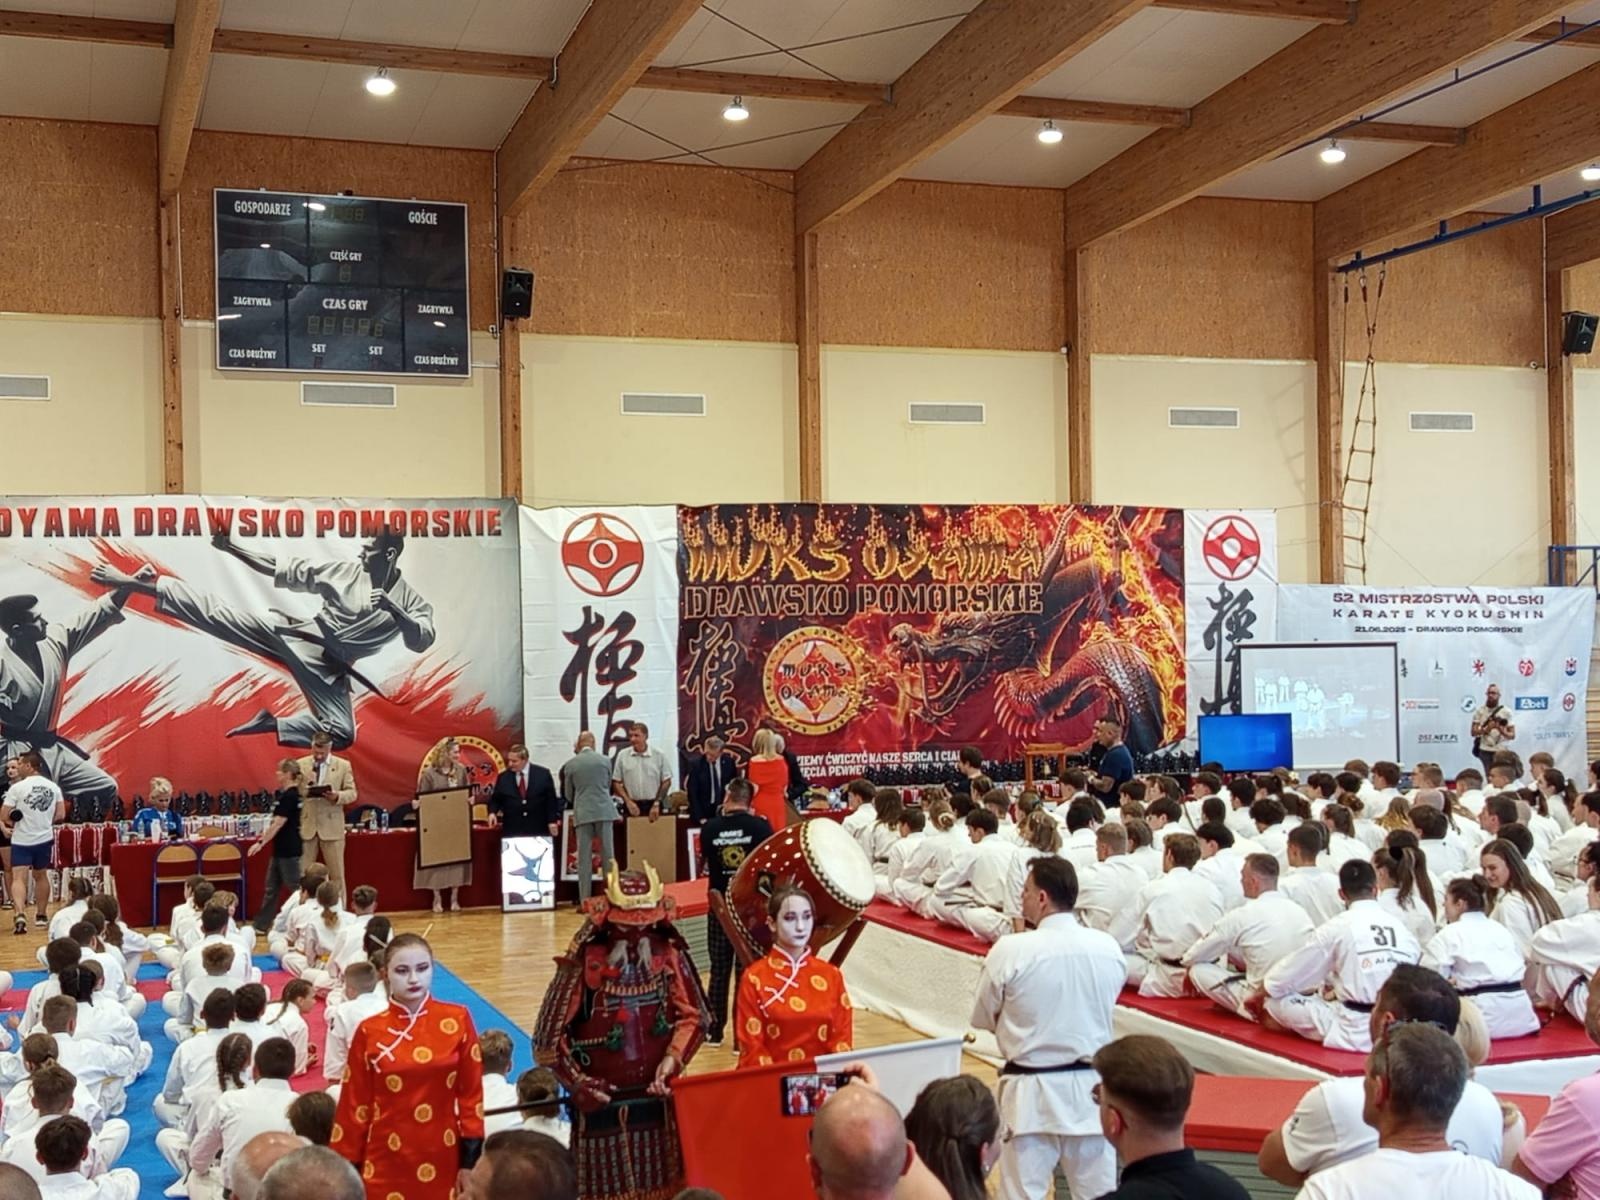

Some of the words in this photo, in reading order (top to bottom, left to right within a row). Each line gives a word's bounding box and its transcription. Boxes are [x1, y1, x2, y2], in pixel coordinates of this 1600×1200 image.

[234, 201, 291, 216] GOSPODARZE
[408, 209, 438, 225] GOŚCIE
[349, 252, 362, 262] GRY
[233, 296, 272, 306] ZAGRYWKA
[322, 298, 347, 310] CZAS
[348, 300, 368, 311] GRY
[417, 304, 454, 315] ZAGRYWKA
[229, 348, 246, 358] CZAS
[246, 346, 277, 360] DRUŻYNY
[311, 343, 327, 353] SET
[368, 346, 383, 355] SET
[414, 356, 430, 365] CZAS
[431, 354, 459, 366] DRUŻYNY
[134, 507, 305, 538] DRAWSKO
[316, 508, 502, 538] POMORSKIE
[684, 584, 850, 620] DRAWSKO
[856, 582, 1044, 615] POMORSKIE
[1333, 593, 1354, 604] 52
[1359, 593, 1481, 605] MISTRZOSTWA
[1487, 595, 1545, 606] POLSKI
[1333, 608, 1415, 619] KARATE
[1426, 609, 1545, 620] KYOKUSHIN
[869, 751, 901, 764] NASZE
[902, 751, 933, 763] SERCA
[1370, 925, 1397, 948] 37
